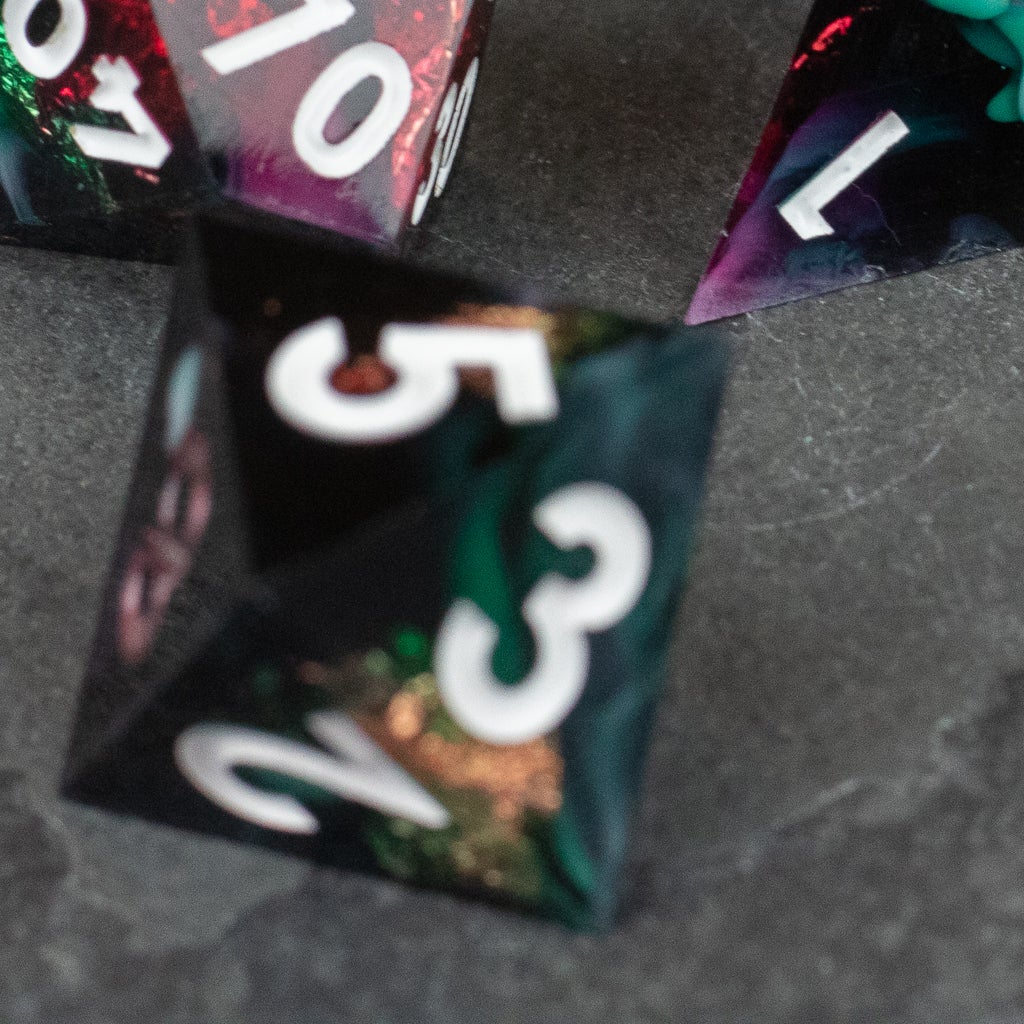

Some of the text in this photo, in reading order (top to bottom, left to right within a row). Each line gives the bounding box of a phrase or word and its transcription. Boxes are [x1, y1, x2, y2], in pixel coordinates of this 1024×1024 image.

[778, 110, 911, 241] 1
[264, 314, 560, 443] 5
[432, 482, 652, 748] 3
[174, 709, 450, 835] 2
